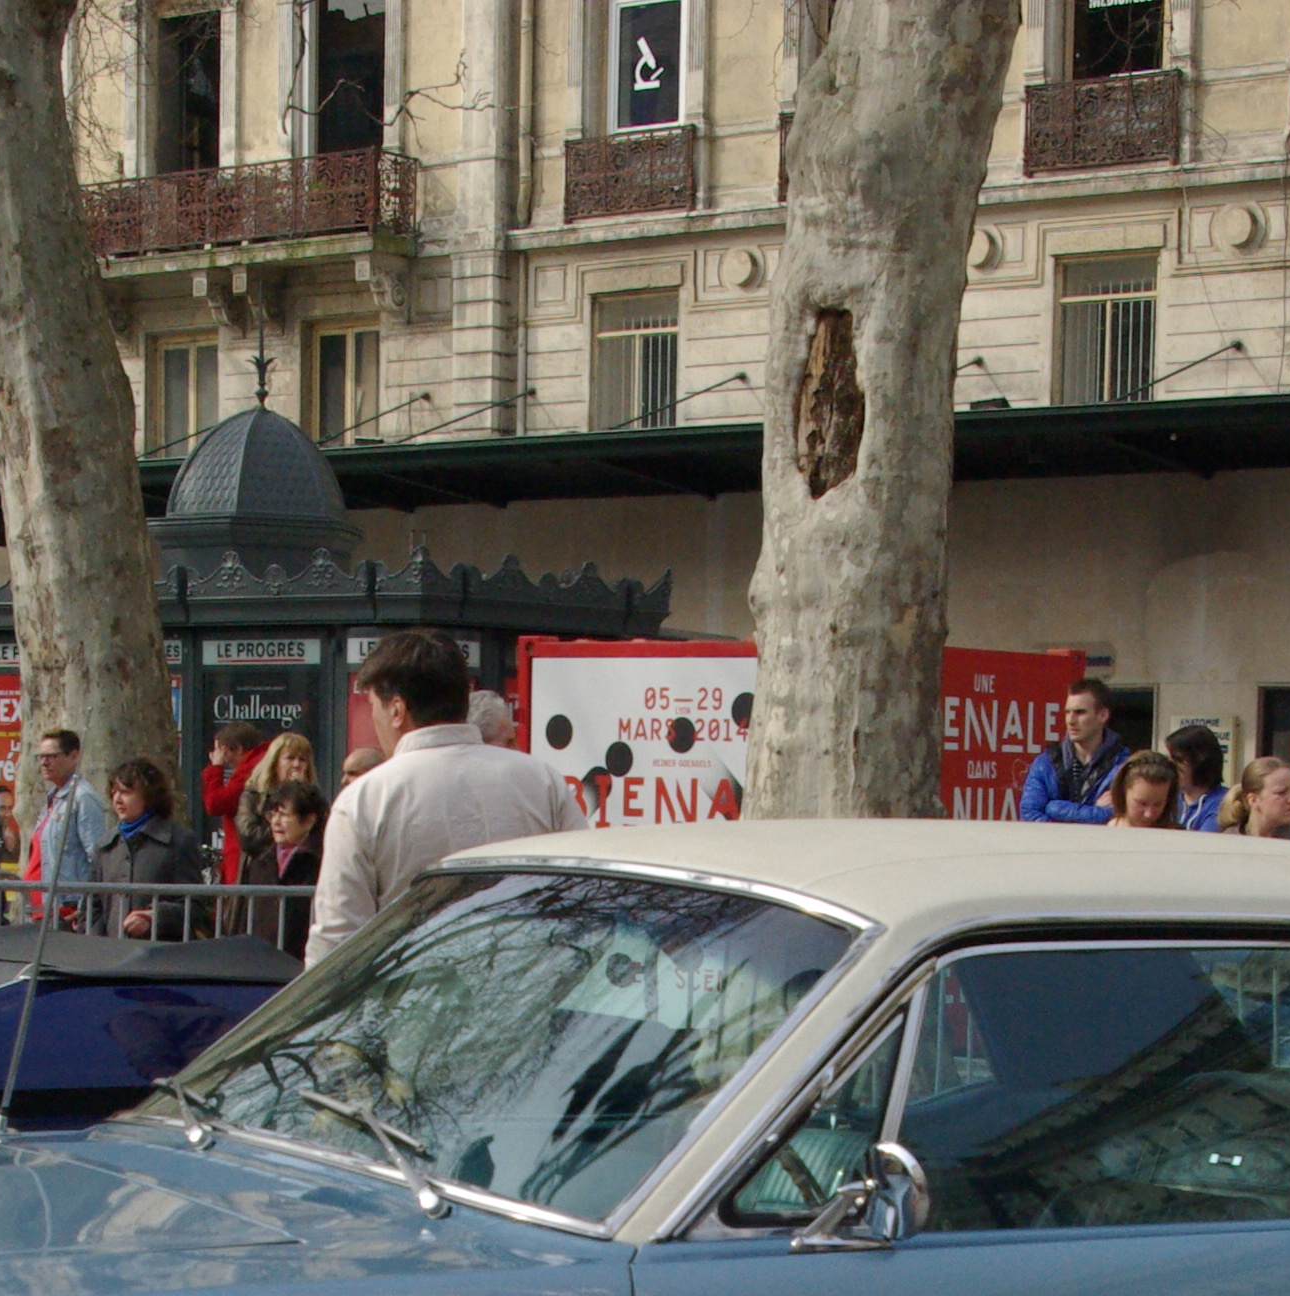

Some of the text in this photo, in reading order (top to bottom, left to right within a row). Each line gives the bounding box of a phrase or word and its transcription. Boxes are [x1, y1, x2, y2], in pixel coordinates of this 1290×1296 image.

[217, 643, 232, 658] LE
[974, 673, 996, 693] UNE
[213, 694, 302, 728] Challenge
[618, 717, 749, 743] MARS 2014
[967, 760, 997, 779] DANS
